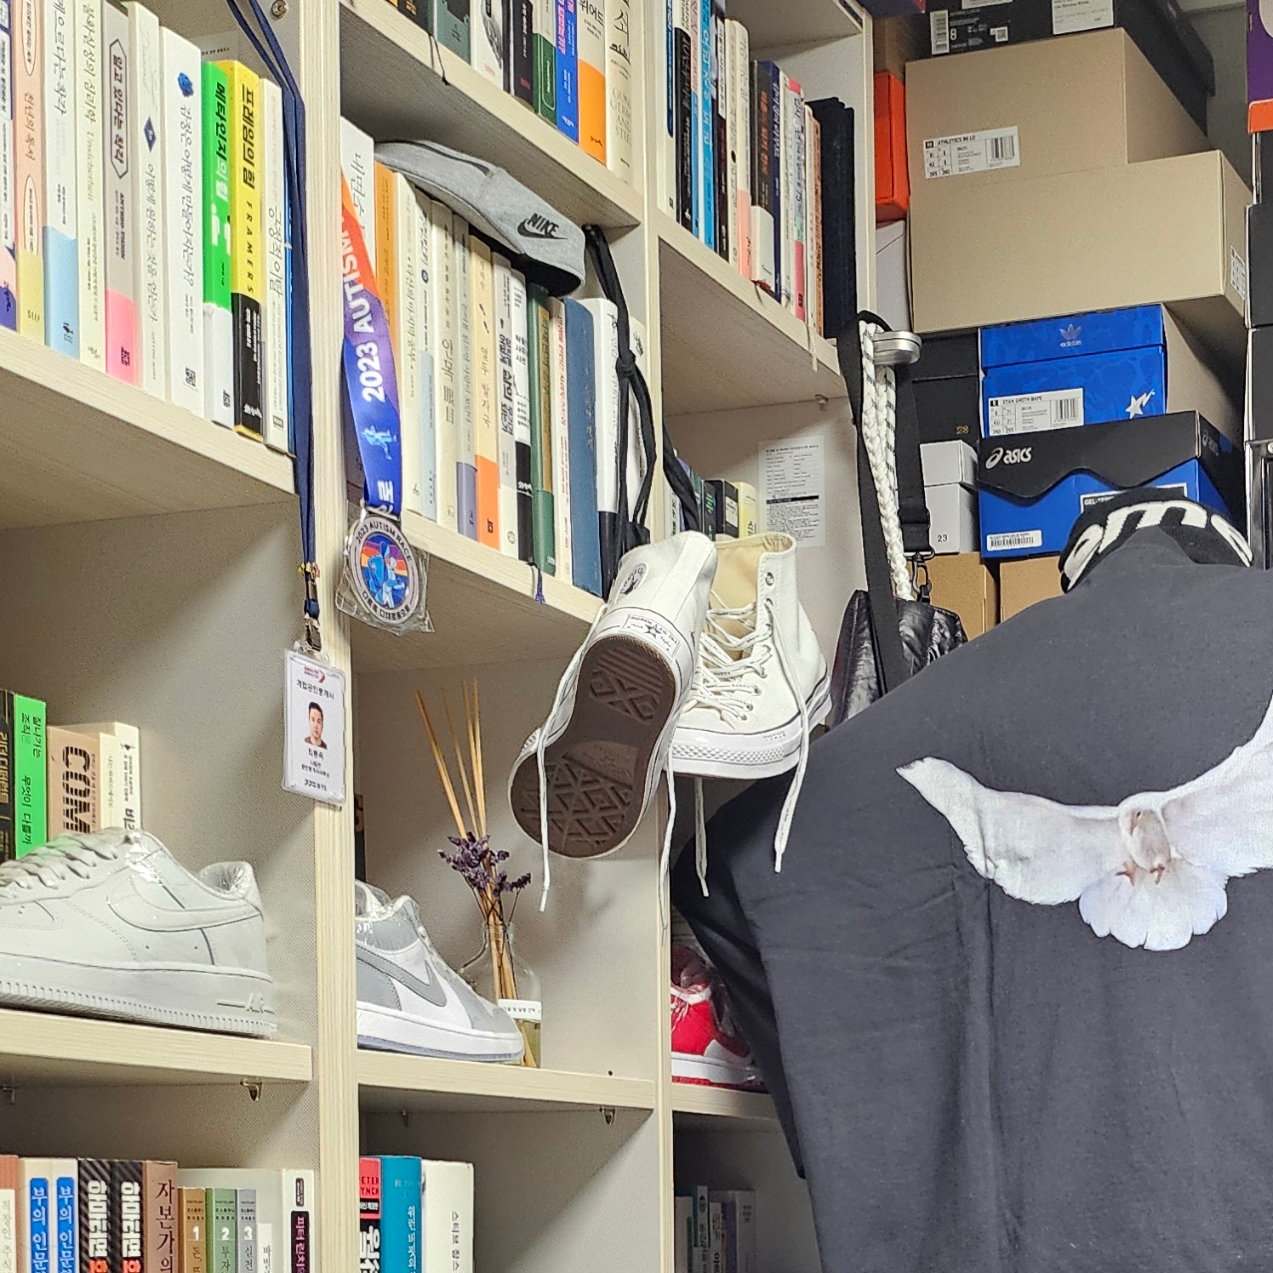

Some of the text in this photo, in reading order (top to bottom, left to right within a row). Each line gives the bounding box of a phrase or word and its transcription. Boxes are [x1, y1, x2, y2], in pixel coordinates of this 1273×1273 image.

[54, 82, 67, 116] 착각
[83, 79, 97, 124] 심리학
[112, 53, 125, 165] 알고 있다는 착각
[24, 92, 36, 161] 천년의 독서
[214, 81, 229, 203] 메타인지의 힘
[241, 83, 256, 190] 프레임의 힘
[144, 163, 156, 204] 어떻게
[179, 104, 195, 287] 감정은 어떻게 만들어지는가?
[146, 208, 157, 249] 원하는
[268, 206, 282, 260] 긍정적
[527, 211, 560, 237] NIKE
[146, 250, 157, 279] 것을
[245, 200, 254, 293] FRAMERS
[269, 260, 284, 299] 이탈
[405, 263, 416, 299] 다산의
[342, 231, 386, 403] 2023 AUTISM
[405, 301, 416, 337] 마지막
[502, 368, 513, 403] 삶의
[1003, 446, 1032, 465] asics
[356, 525, 369, 543] 2023
[936, 533, 949, 543] 23
[20, 711, 33, 845] 조직은 무엇이 다를까
[32, 1186, 48, 1226] 부의
[59, 1185, 74, 1225] 부의
[88, 1179, 109, 1258] 하마터면
[120, 1180, 142, 1258] 하마터면
[407, 1205, 417, 1232] 워런
[192, 1225, 200, 1241] 1
[220, 1227, 230, 1241] 2
[243, 1225, 253, 1241] 3
[295, 1215, 306, 1242] 피터
[451, 1210, 461, 1272] 스티브 잡스
[244, 1245, 254, 1272] 실전
[407, 1232, 417, 1270] 버핏의
